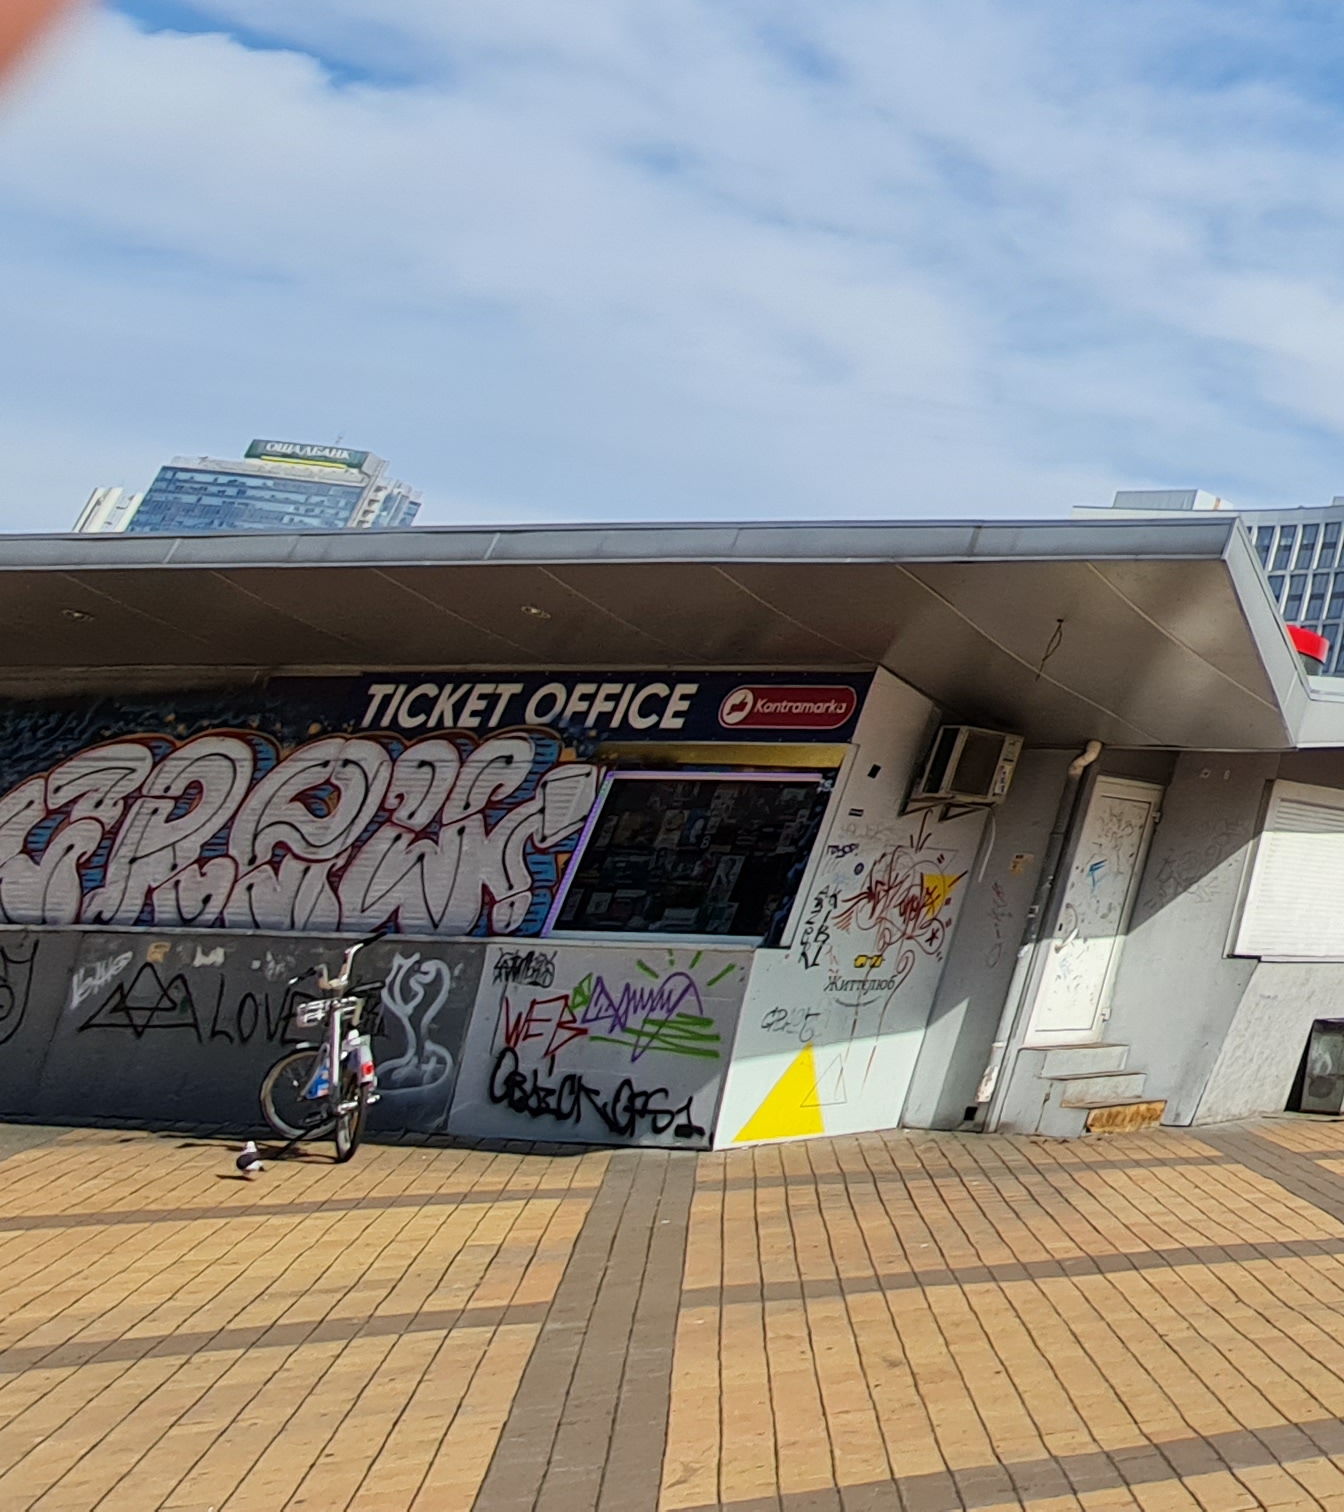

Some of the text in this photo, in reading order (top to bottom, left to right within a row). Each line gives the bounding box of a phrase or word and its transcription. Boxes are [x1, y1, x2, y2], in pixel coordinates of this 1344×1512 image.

[361, 684, 699, 729] TICKET OFFICE
[753, 698, 848, 714] Kontramarka
